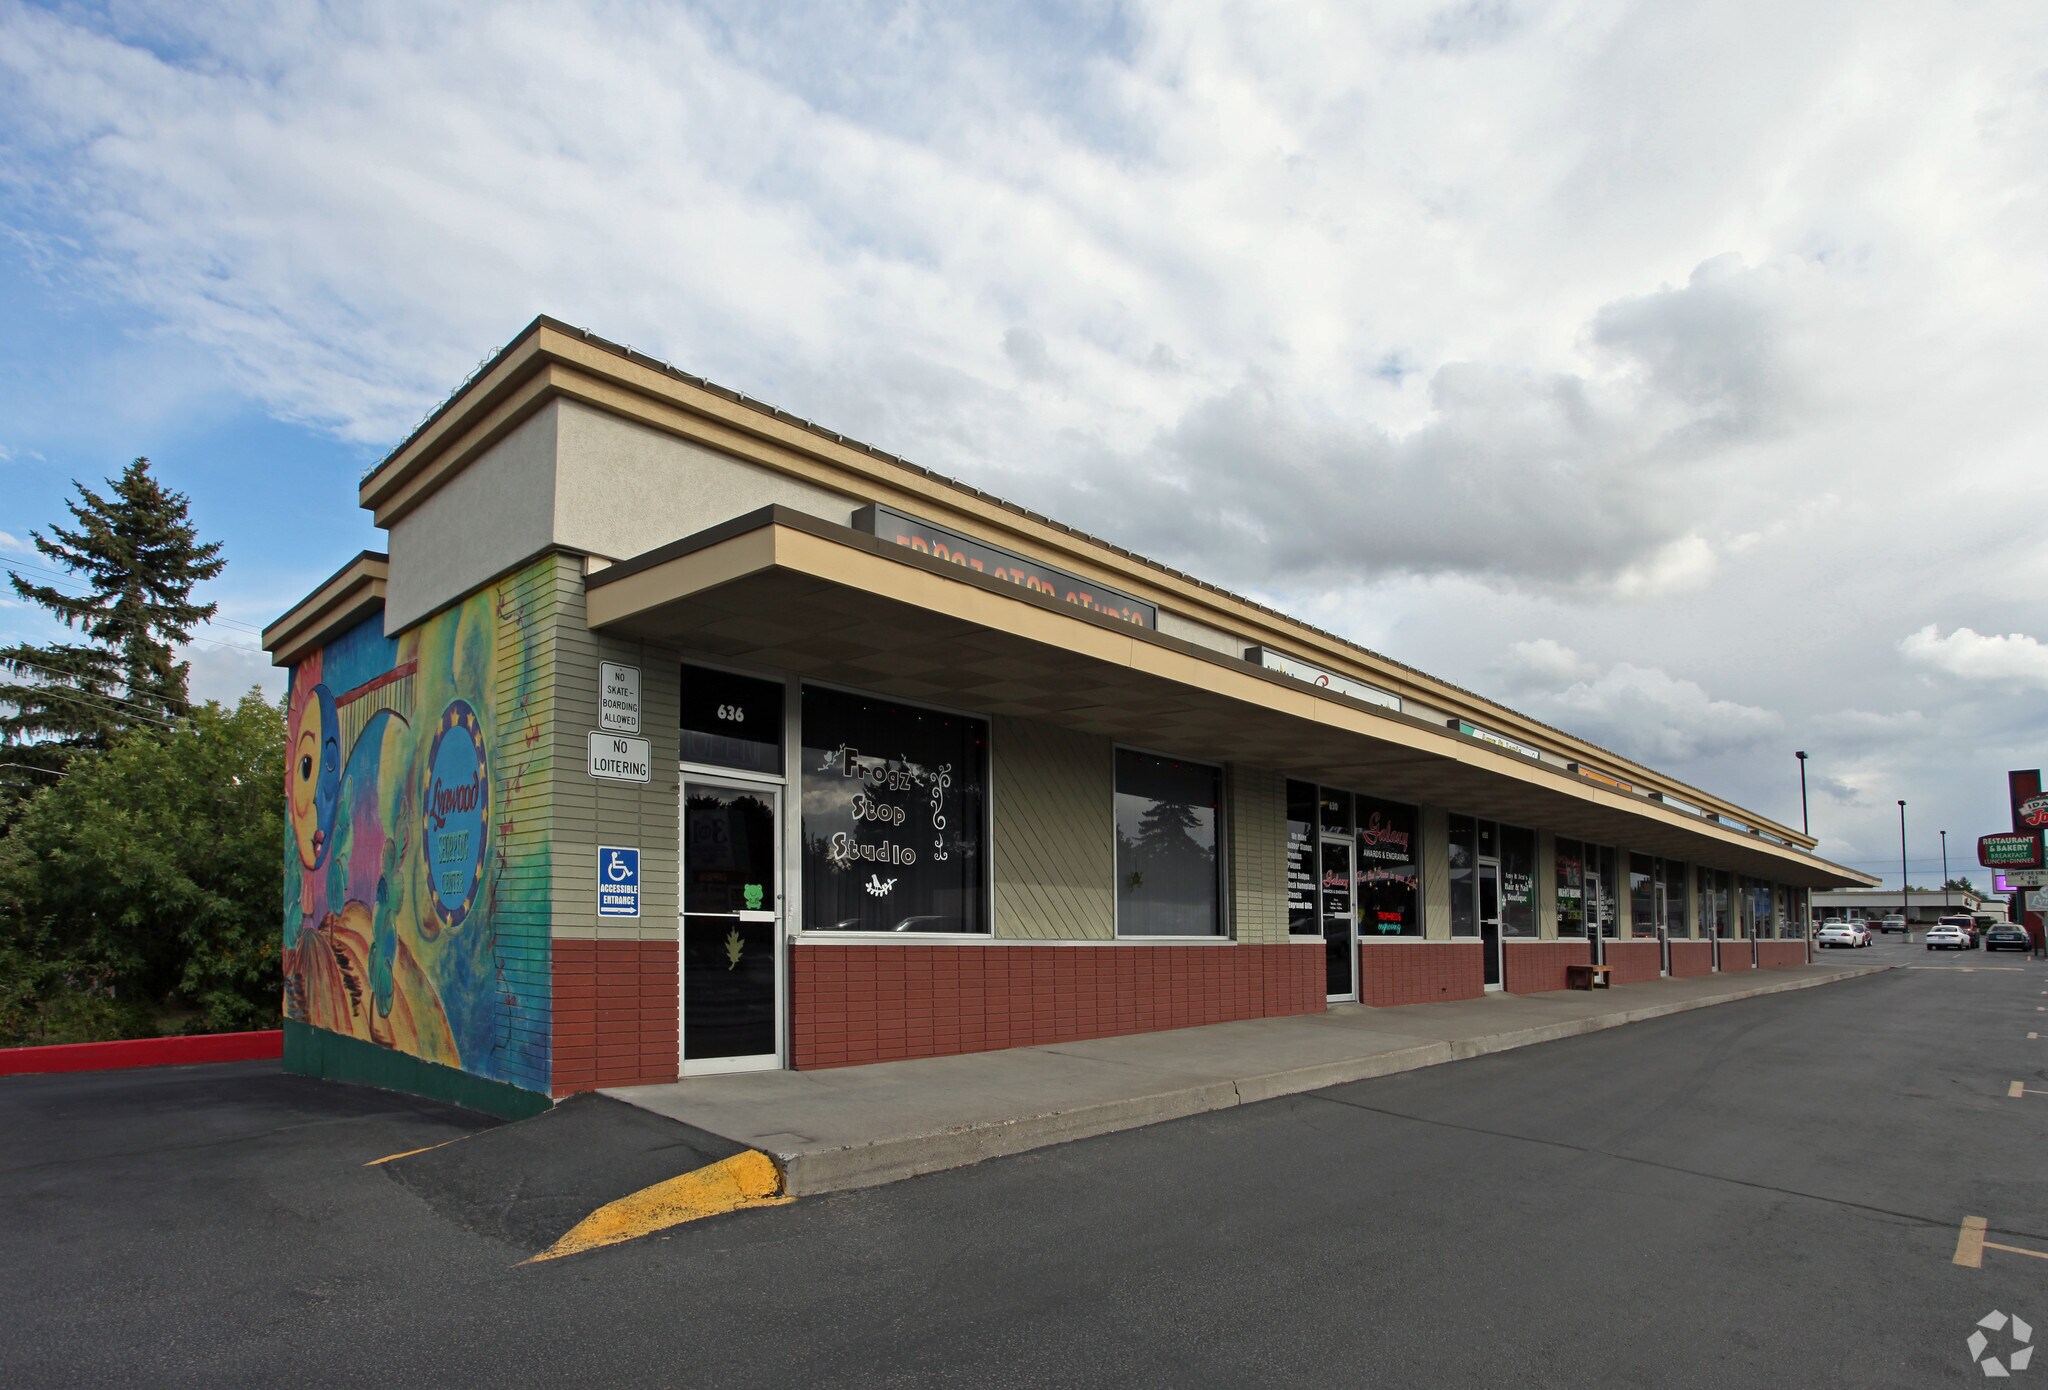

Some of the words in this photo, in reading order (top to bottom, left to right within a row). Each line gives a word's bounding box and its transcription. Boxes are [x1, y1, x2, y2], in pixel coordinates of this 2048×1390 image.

[615, 672, 625, 682] NO
[607, 685, 634, 697] SKATE-
[602, 698, 638, 713] BOARDING
[604, 713, 636, 726] ALLOWED
[717, 704, 745, 723] 636
[613, 740, 628, 754] NO
[594, 757, 647, 776] LOITERING
[843, 747, 911, 791] Frogz
[430, 770, 479, 832] Lynwood
[851, 793, 906, 826] Stop
[1362, 811, 1408, 852] Galaxy
[439, 830, 469, 864] SHOPPING
[1983, 837, 2034, 845] RESTAURANT
[1997, 844, 2028, 852] BAKERY
[832, 831, 917, 866] Studio
[1363, 849, 1381, 859] AWARDS
[1386, 851, 1409, 862] ENGRAVING
[442, 870, 464, 894] CENTER
[600, 884, 638, 894] ACCESSIBLE
[1504, 882, 1514, 891] Hair
[603, 895, 635, 905] ENTRANCE
[1507, 893, 1527, 903] Boutique
